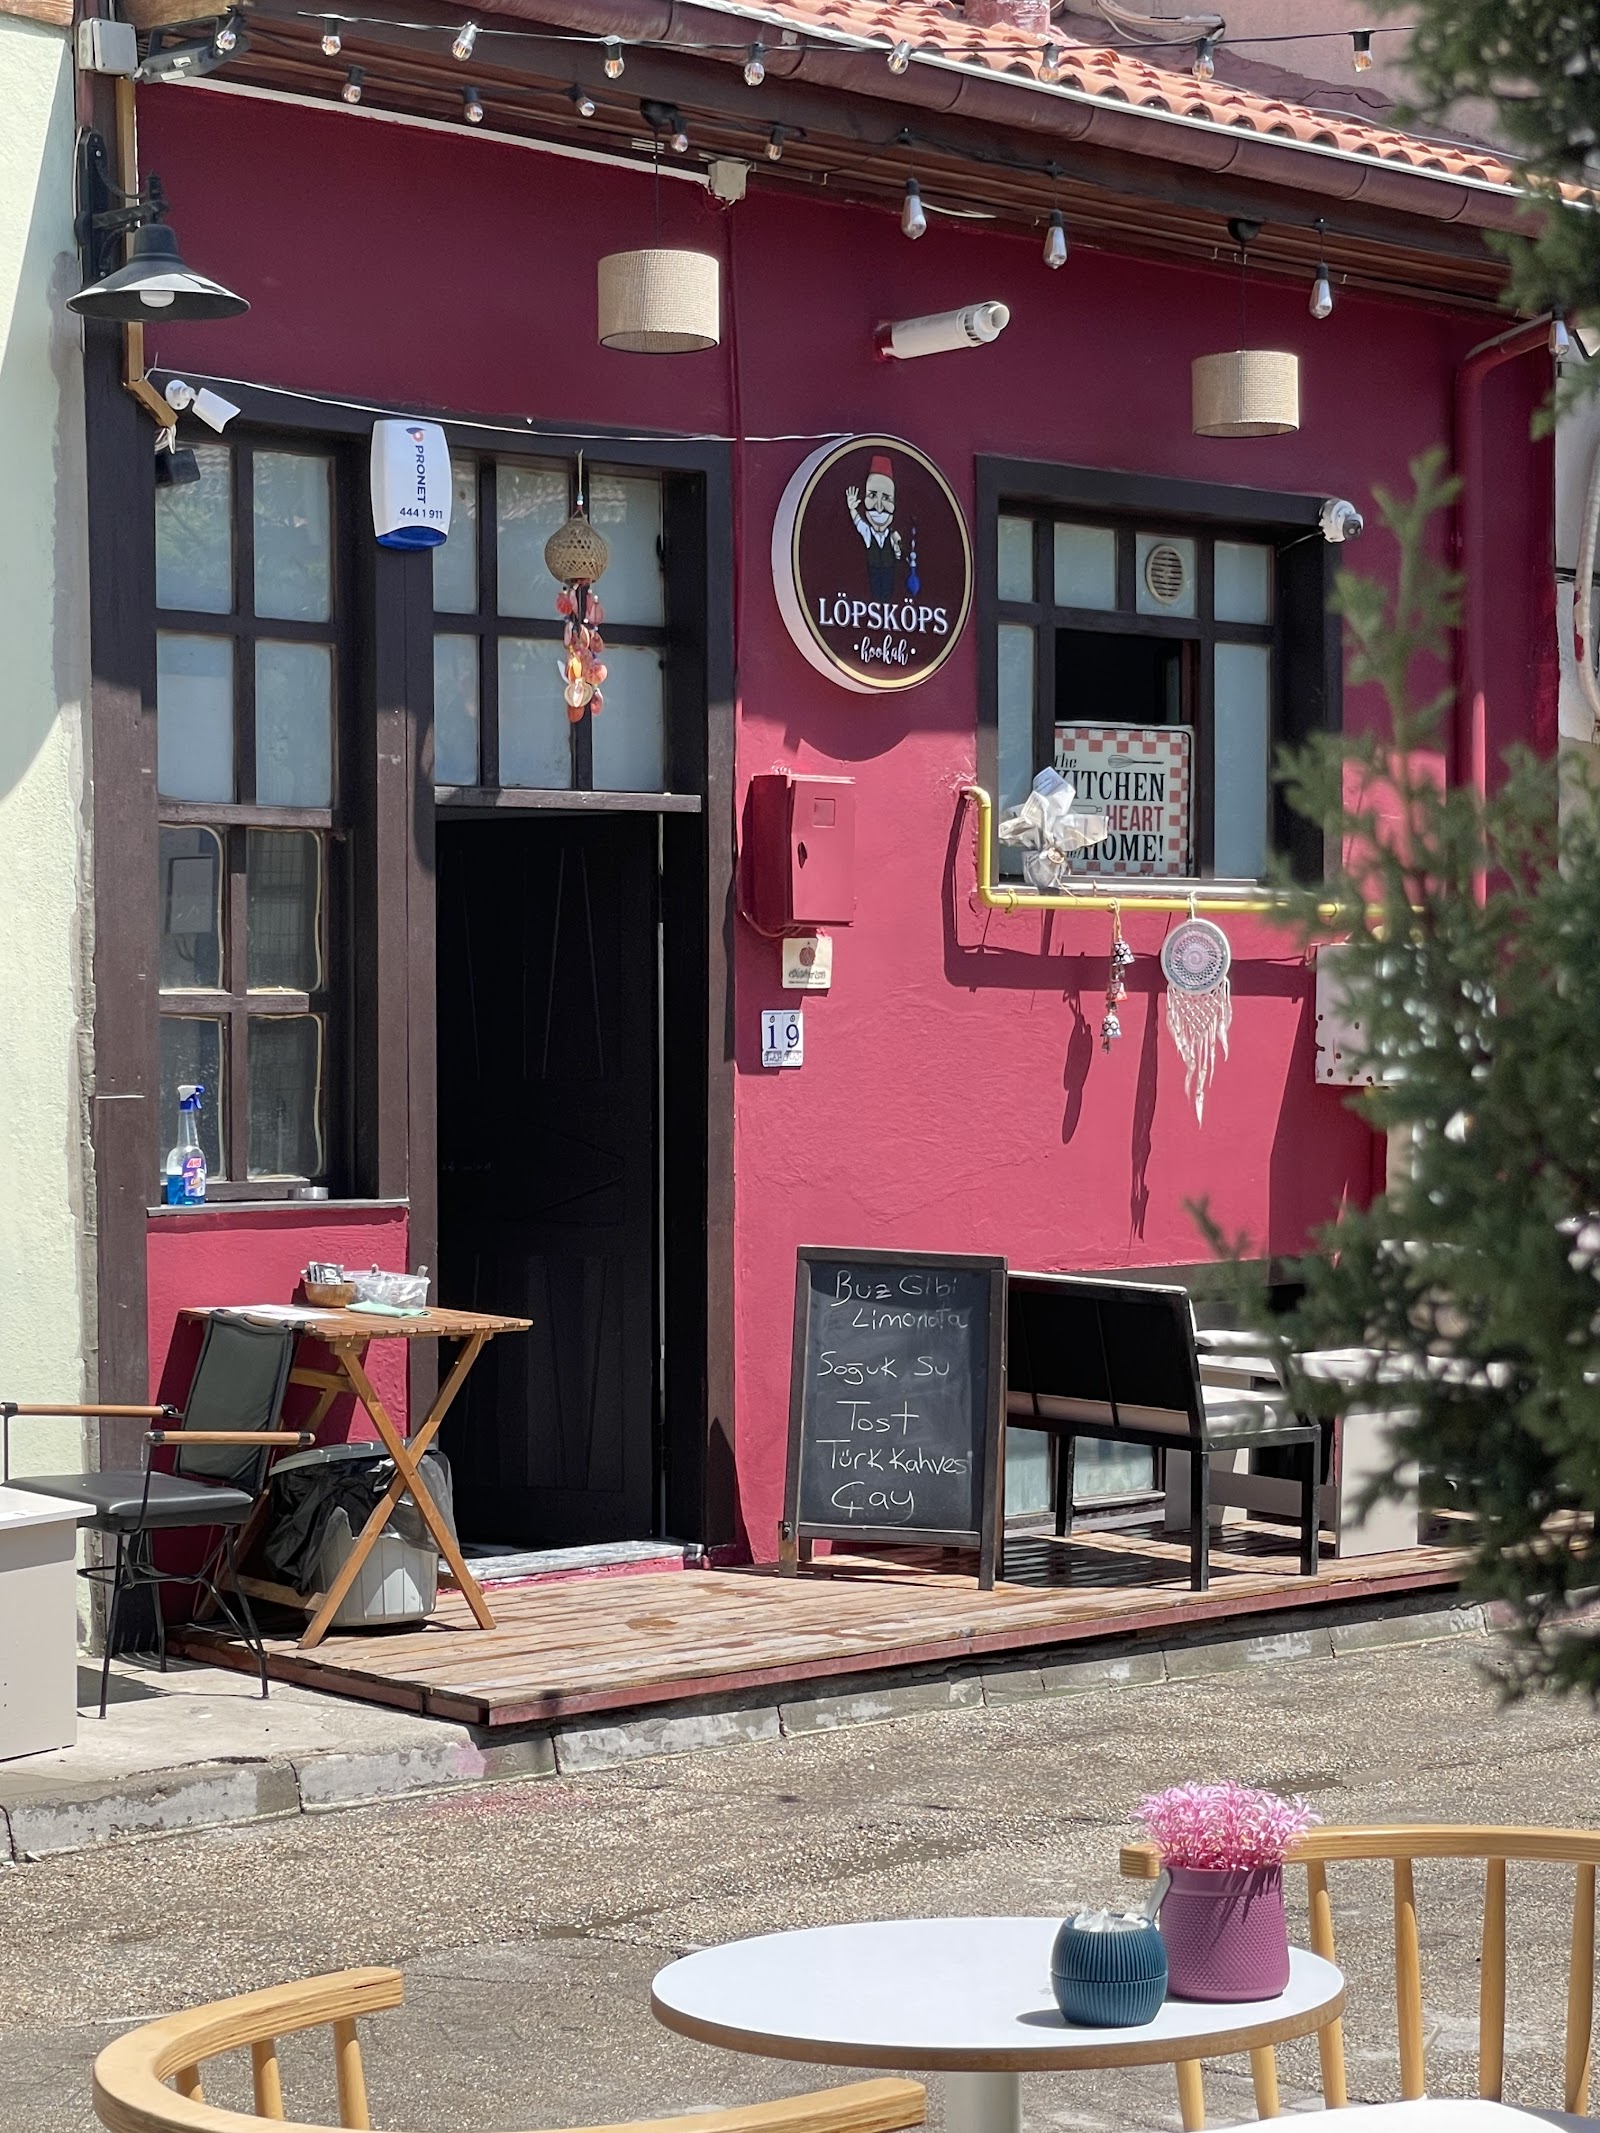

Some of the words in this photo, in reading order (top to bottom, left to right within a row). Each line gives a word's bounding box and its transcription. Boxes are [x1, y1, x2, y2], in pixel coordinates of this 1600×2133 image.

[415, 445, 426, 504] PRONET
[400, 507, 419, 517] 444
[429, 509, 443, 519] 911
[818, 592, 949, 634] LÖPSKÖPS
[860, 634, 909, 665] hookah
[1105, 804, 1164, 832] HEART
[852, 1303, 968, 1330] Limonata
[817, 1351, 897, 1385] Soğuk
[914, 1356, 950, 1376] Su
[836, 1401, 919, 1435] Tost
[816, 1440, 884, 1471] Türk
[831, 1481, 915, 1525] Çay
